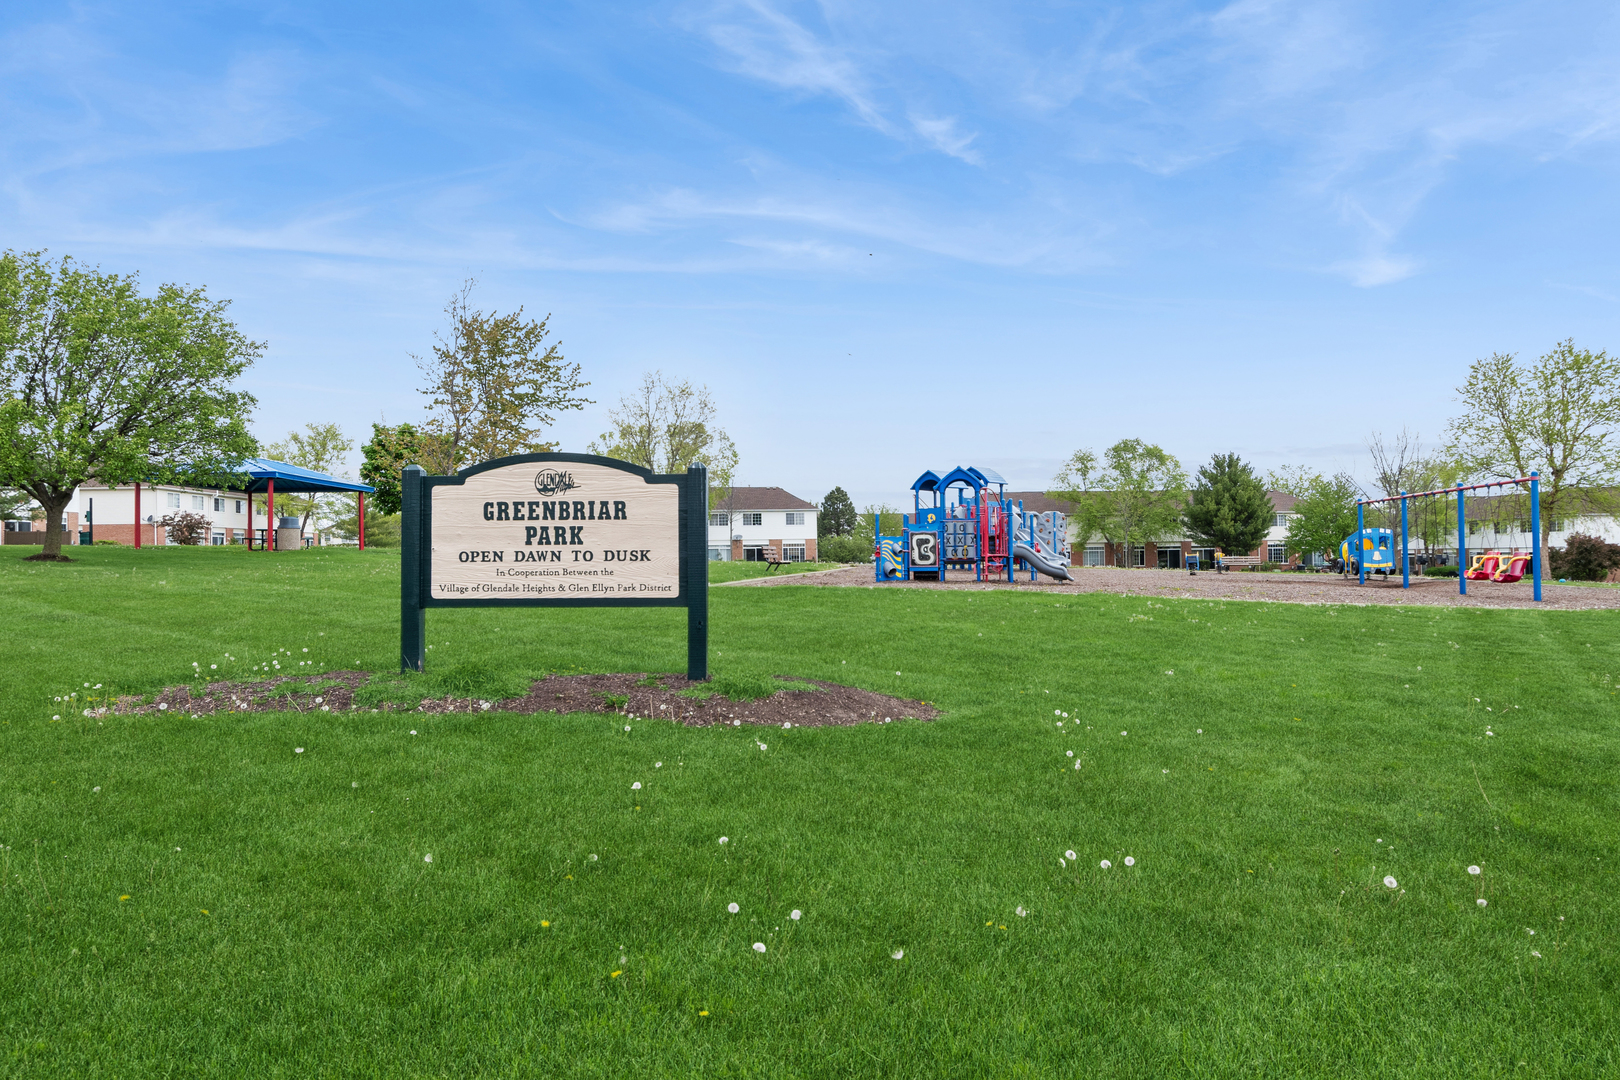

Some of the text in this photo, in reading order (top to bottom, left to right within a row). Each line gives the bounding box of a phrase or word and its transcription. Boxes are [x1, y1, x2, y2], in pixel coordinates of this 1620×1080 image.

[483, 500, 628, 521] GREENBRIAR
[524, 525, 584, 546] PARK
[458, 549, 652, 563] OPEN DAWN TO DUSK
[496, 567, 614, 579] In Cooperation Between the
[439, 583, 672, 595] Village of Glendale Heights & Glen Ellyn Park District
